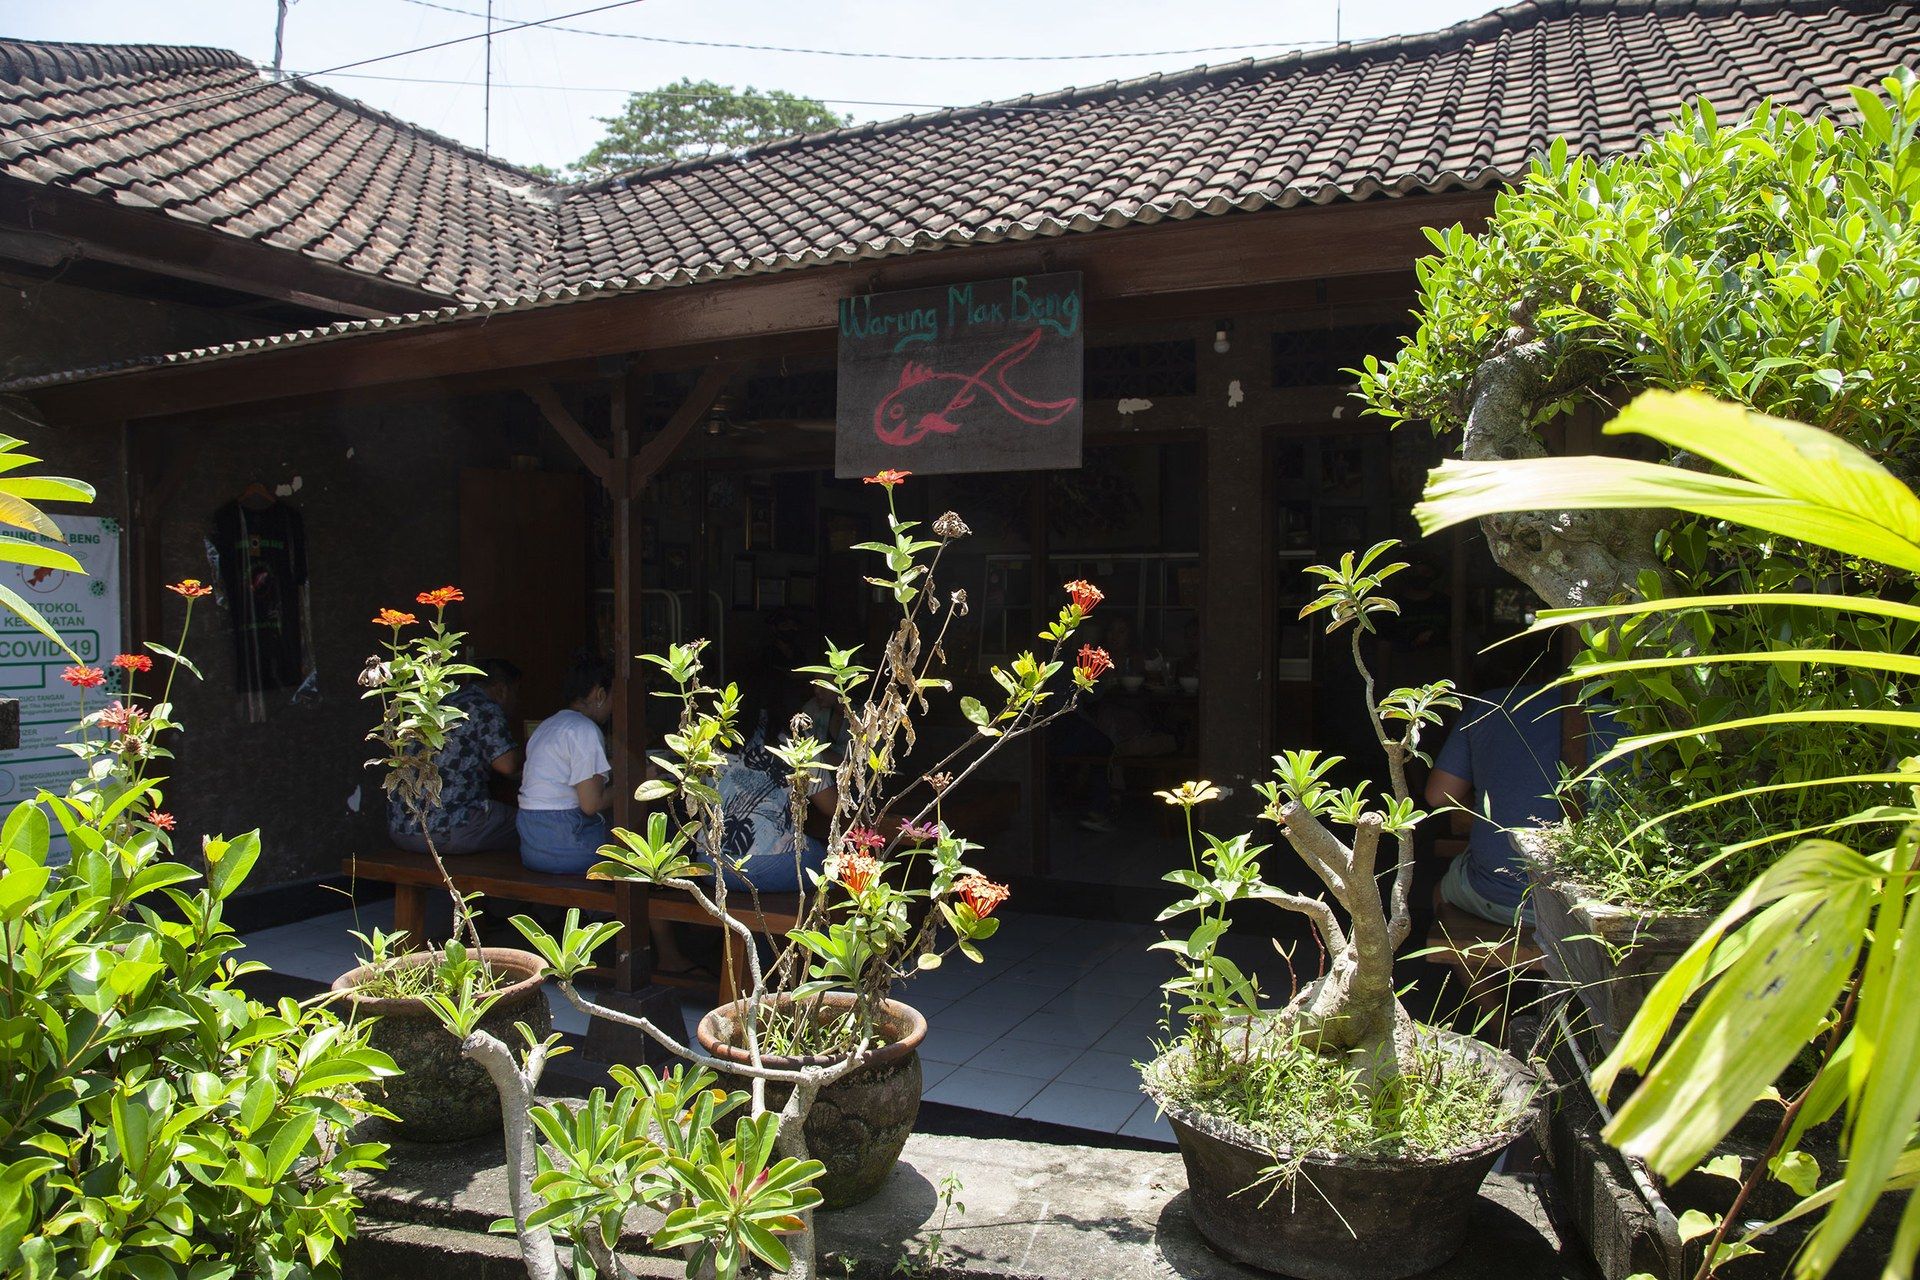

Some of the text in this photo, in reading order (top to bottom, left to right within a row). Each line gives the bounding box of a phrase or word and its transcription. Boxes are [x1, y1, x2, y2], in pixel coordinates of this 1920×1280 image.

[839, 295, 938, 352] Warung
[1010, 277, 1081, 337] Beng
[69, 533, 100, 544] BENG
[7, 602, 82, 613] TOKOL
